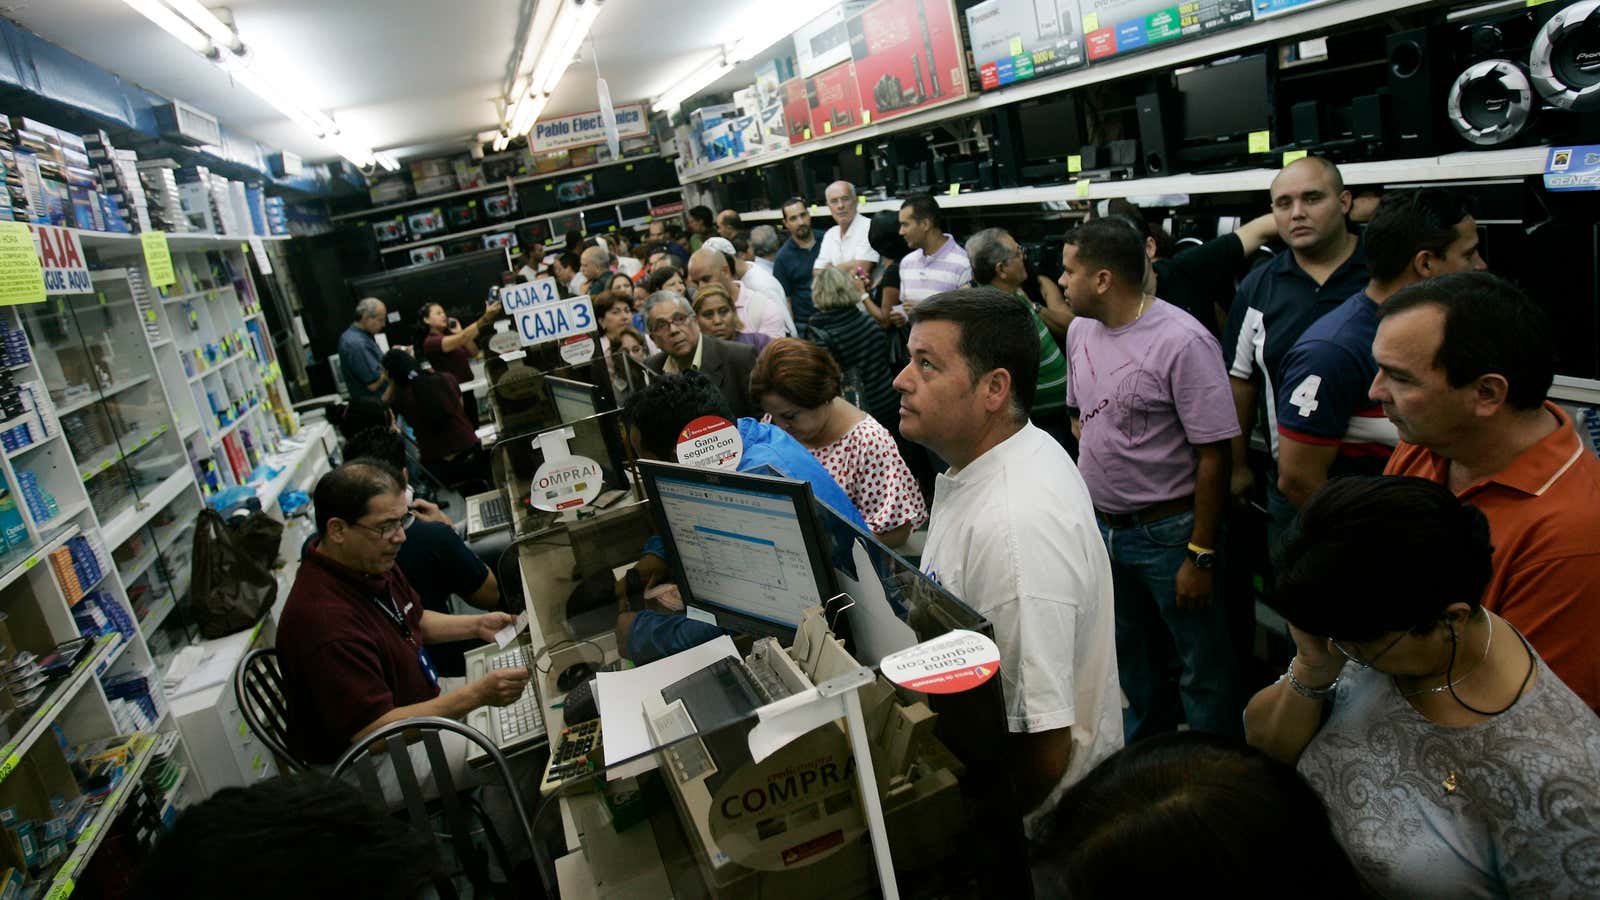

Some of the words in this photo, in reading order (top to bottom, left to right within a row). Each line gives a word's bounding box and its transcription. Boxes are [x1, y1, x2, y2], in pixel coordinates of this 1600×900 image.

[536, 121, 570, 139] Pablo
[572, 110, 640, 133] Electnica
[28, 225, 82, 268] AJA
[44, 270, 67, 290] GUE
[69, 271, 91, 292] AQUI
[505, 287, 541, 310] CAJA
[542, 282, 555, 301] 2
[521, 308, 570, 340] CAJA
[572, 303, 592, 329] 3
[1288, 374, 1323, 418] 4
[683, 445, 715, 460] seguro
[716, 437, 734, 449] con
[694, 435, 719, 448] Gana
[896, 658, 927, 671] con
[924, 657, 967, 672] Gana
[930, 645, 986, 663] seguro
